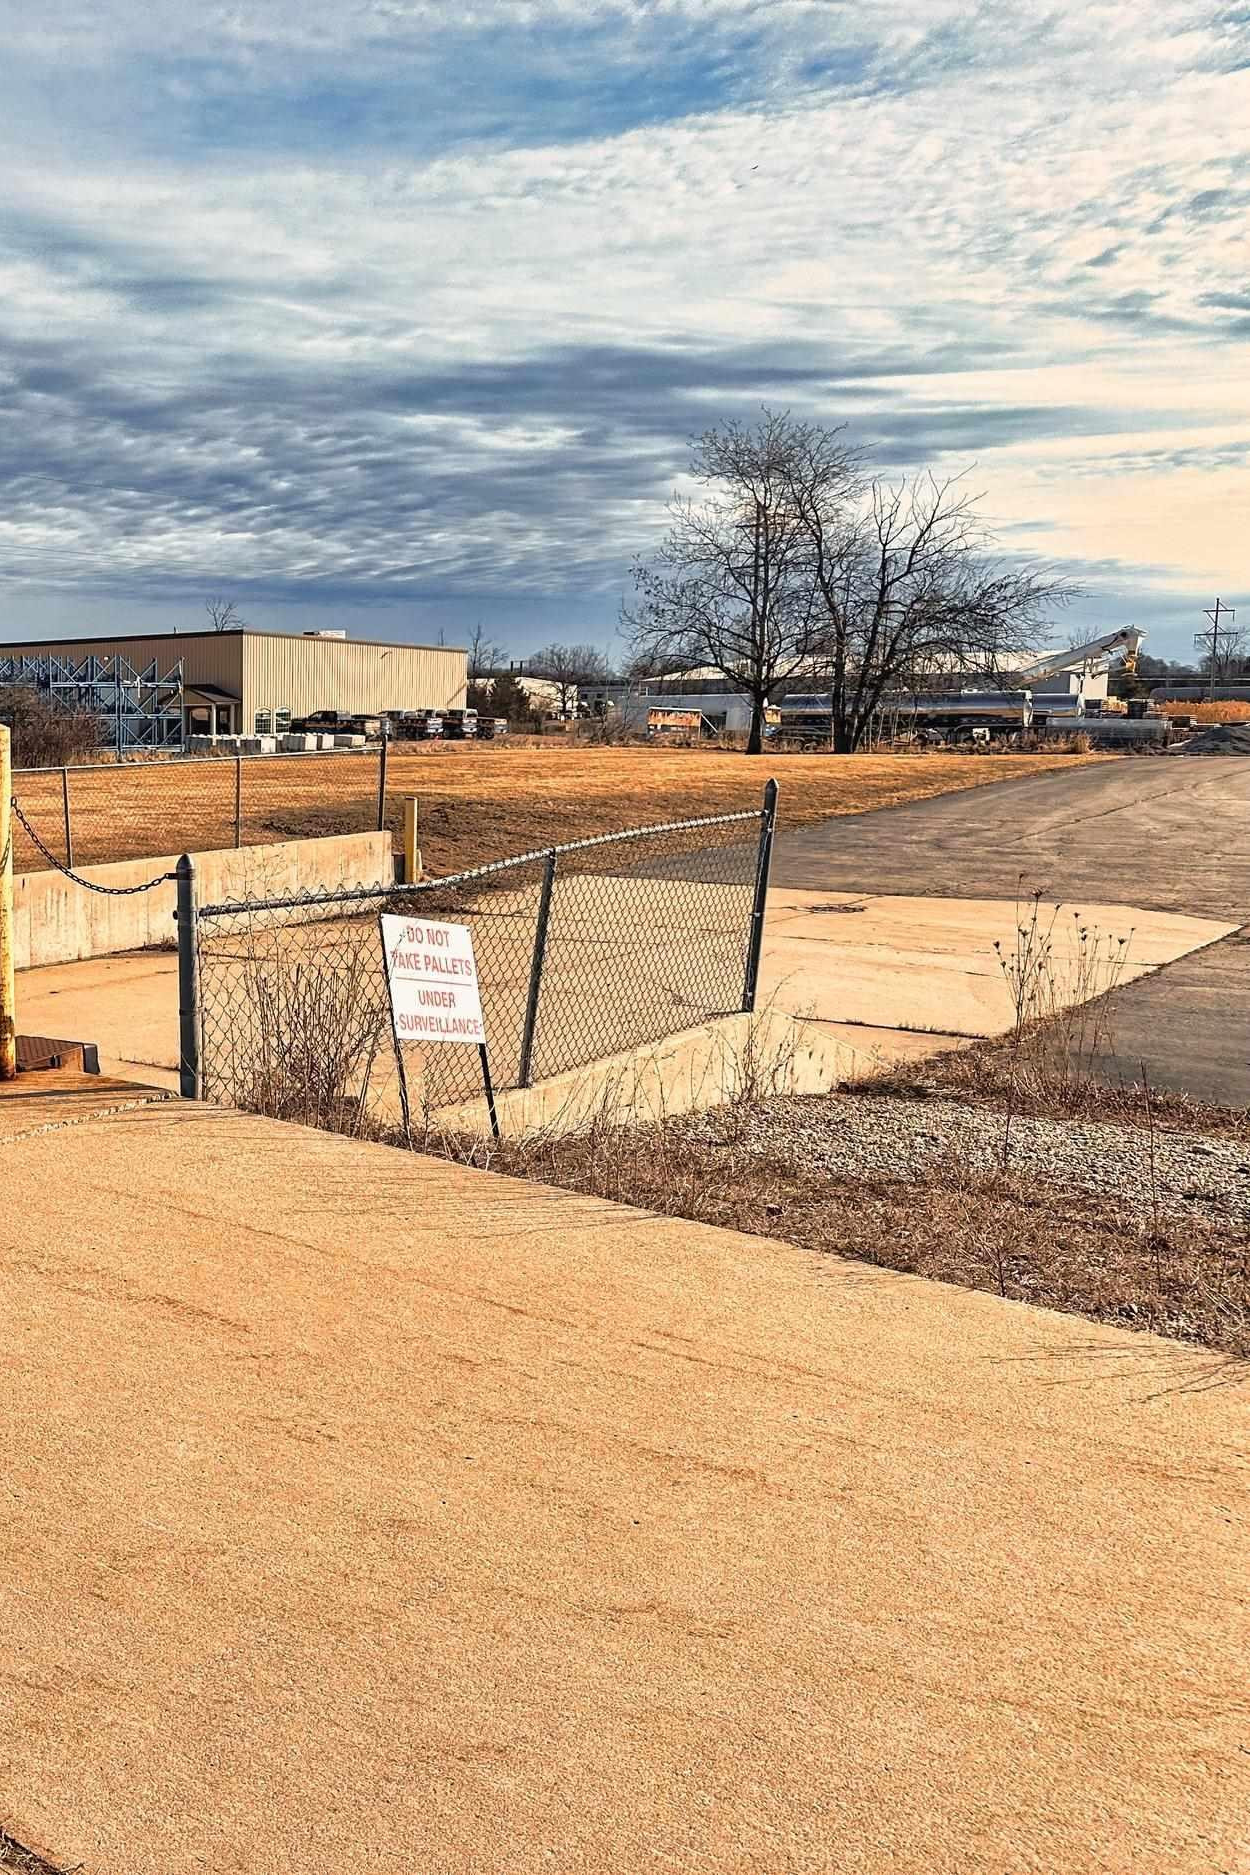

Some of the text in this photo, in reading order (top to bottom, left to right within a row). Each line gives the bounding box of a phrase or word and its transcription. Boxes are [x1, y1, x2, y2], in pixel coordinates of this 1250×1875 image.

[406, 925, 450, 948] DO NOT
[424, 954, 472, 977] PALLETS
[418, 989, 456, 1009] UNDER
[398, 1013, 481, 1036] SURVEILLANCE
